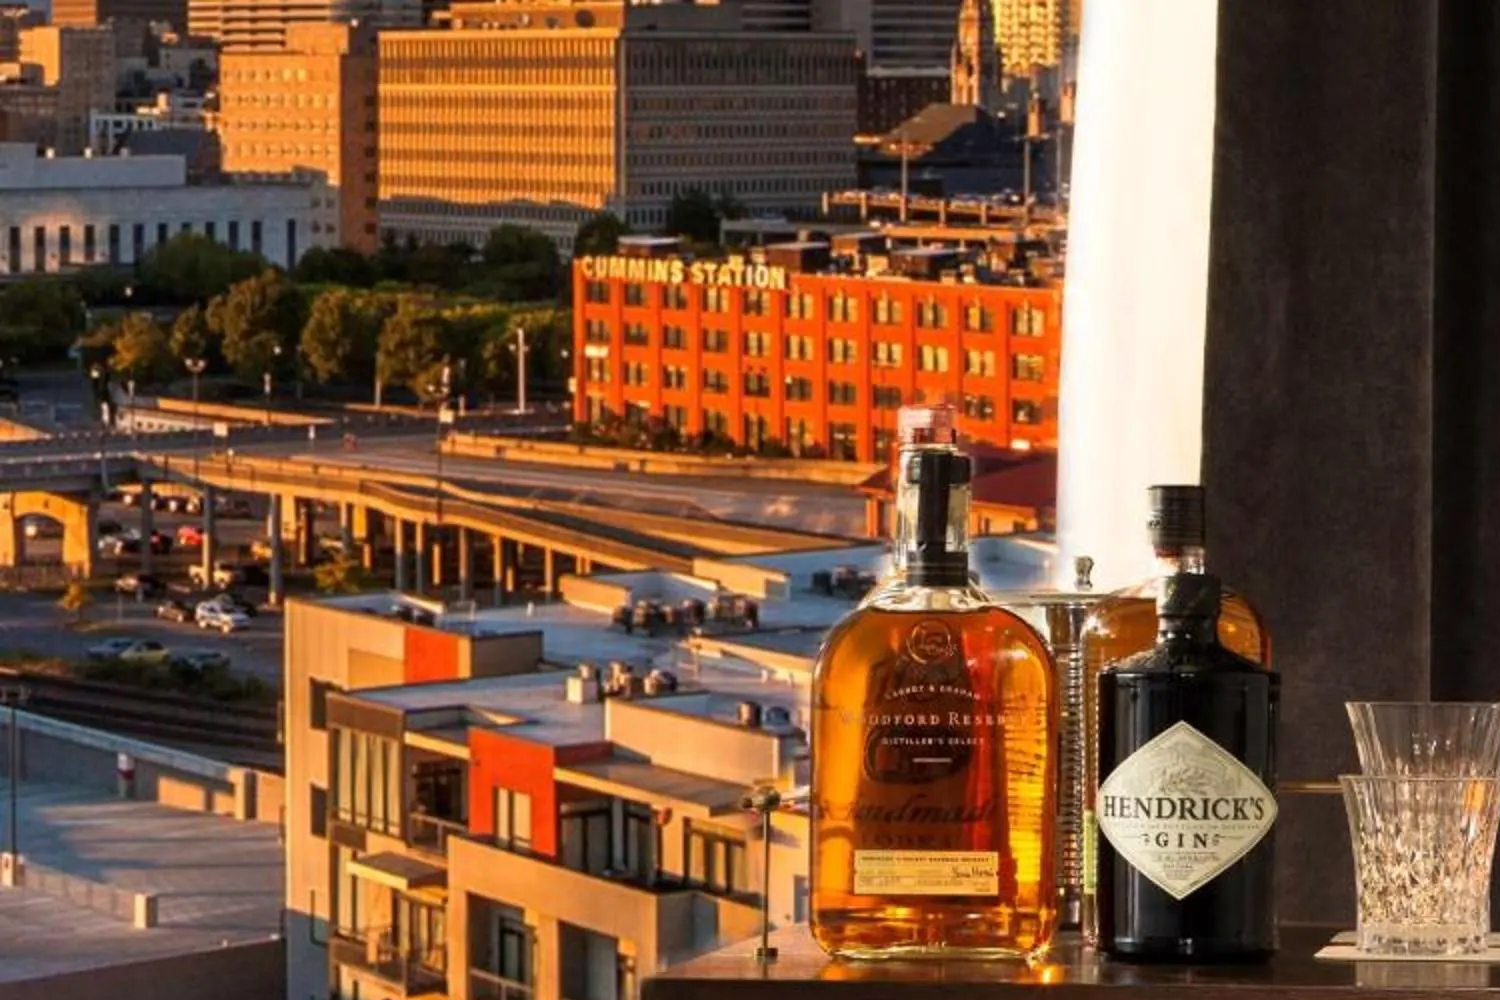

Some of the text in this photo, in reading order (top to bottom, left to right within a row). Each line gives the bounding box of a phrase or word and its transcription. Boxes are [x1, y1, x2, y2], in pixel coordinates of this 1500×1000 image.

[580, 255, 786, 289] CUMMINS STATION
[839, 711, 1031, 728] ODFORD RESER
[1103, 795, 1266, 822] HENDRICK'S
[1155, 831, 1208, 848] GIN
